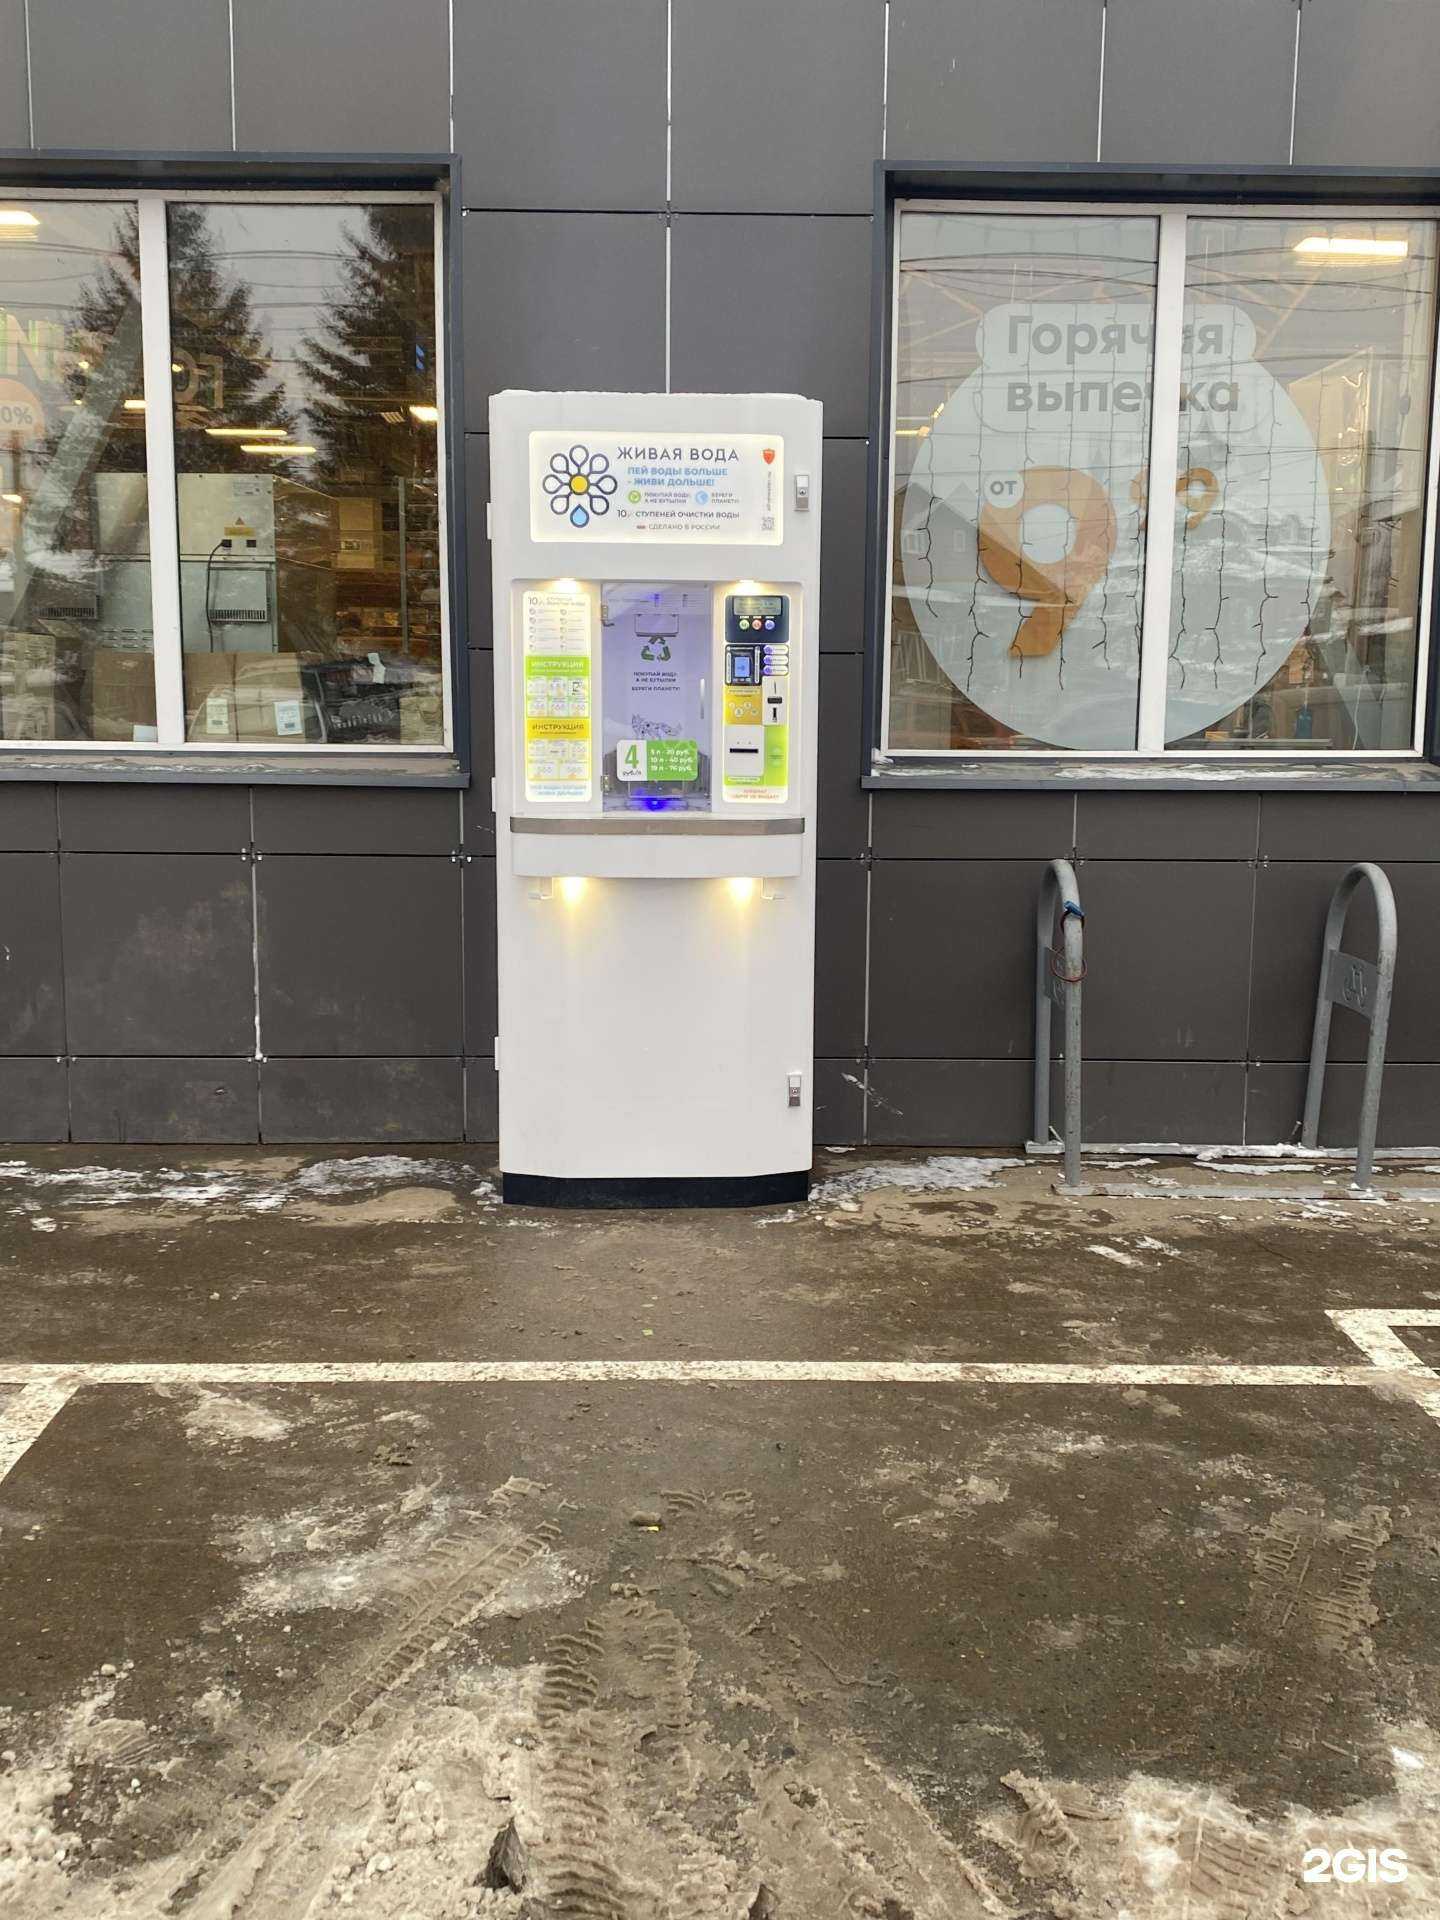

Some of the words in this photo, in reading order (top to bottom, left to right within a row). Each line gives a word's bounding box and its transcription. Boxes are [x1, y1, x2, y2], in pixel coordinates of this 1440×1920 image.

[1007, 381, 1238, 412] выпека
[617, 447, 682, 460] ЖИВАЯ
[690, 448, 739, 462] ВОДА
[627, 465, 649, 475] ПЕЙ
[650, 466, 682, 476] ВОДЫ
[684, 467, 728, 476] БОЛЬШЕ
[634, 477, 665, 486] ЖИВИ
[635, 510, 677, 518] СТУПЕНЕЙ
[677, 511, 714, 519] ОЧИСТКИ
[648, 523, 683, 531] СДЕЛАНО
[624, 744, 639, 768] 4
